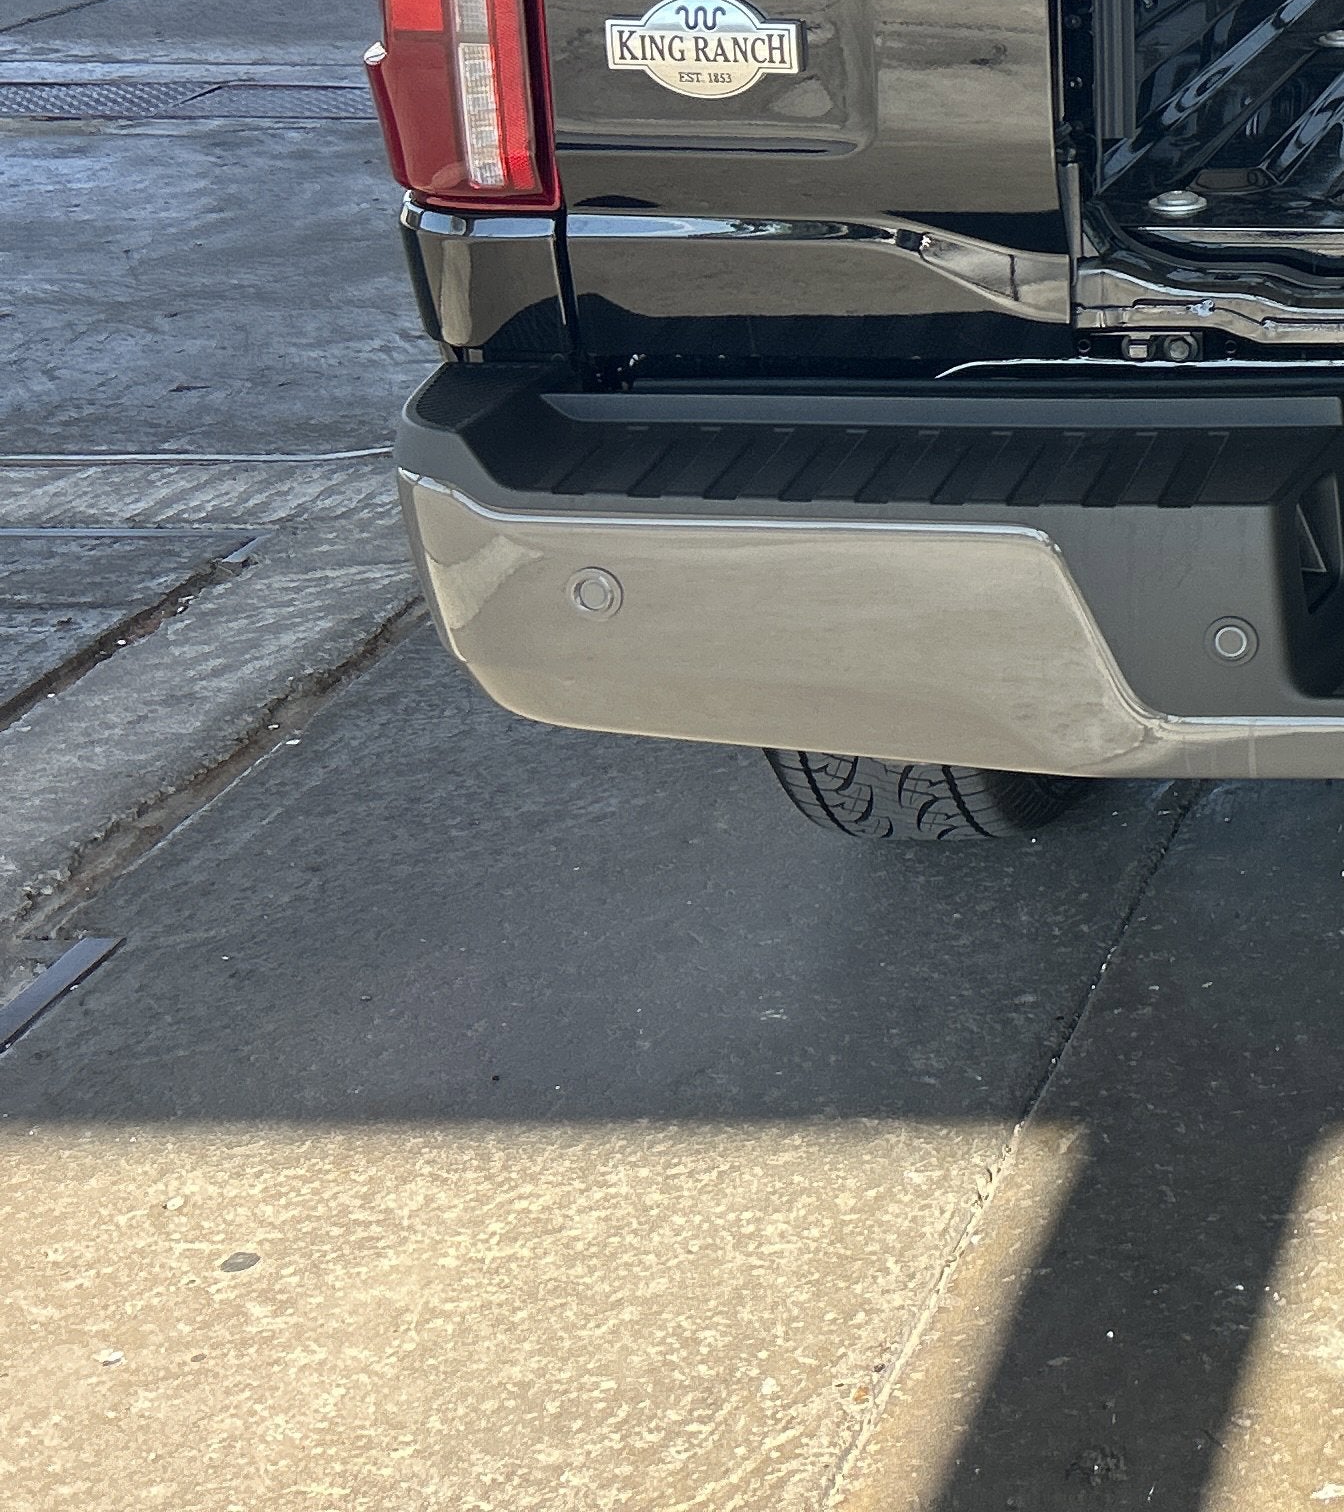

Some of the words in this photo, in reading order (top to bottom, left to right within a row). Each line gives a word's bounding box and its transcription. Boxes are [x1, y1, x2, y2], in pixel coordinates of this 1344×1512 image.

[617, 29, 686, 62] KING
[693, 33, 787, 65] RANCH
[708, 72, 733, 84] 1853
